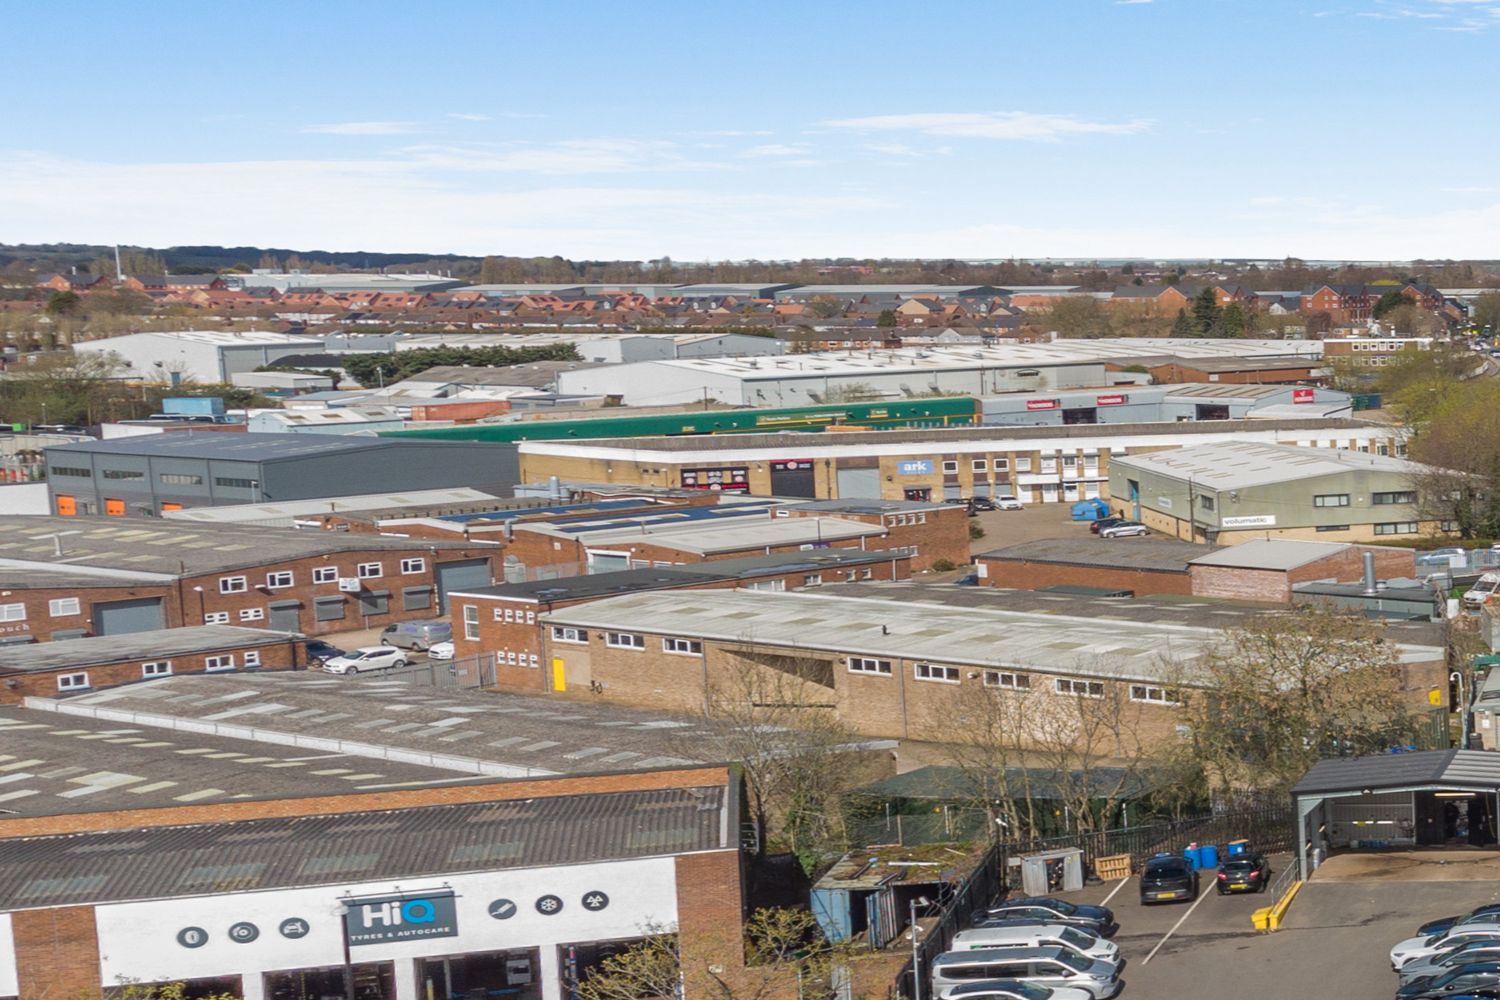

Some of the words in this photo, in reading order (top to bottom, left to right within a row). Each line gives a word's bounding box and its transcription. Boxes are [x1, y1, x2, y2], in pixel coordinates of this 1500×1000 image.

[903, 461, 928, 471] ark
[1224, 517, 1268, 525] volumatic
[362, 899, 436, 928] HiQ
[350, 933, 384, 941] TYRES
[397, 926, 451, 937] AUTOCARE
